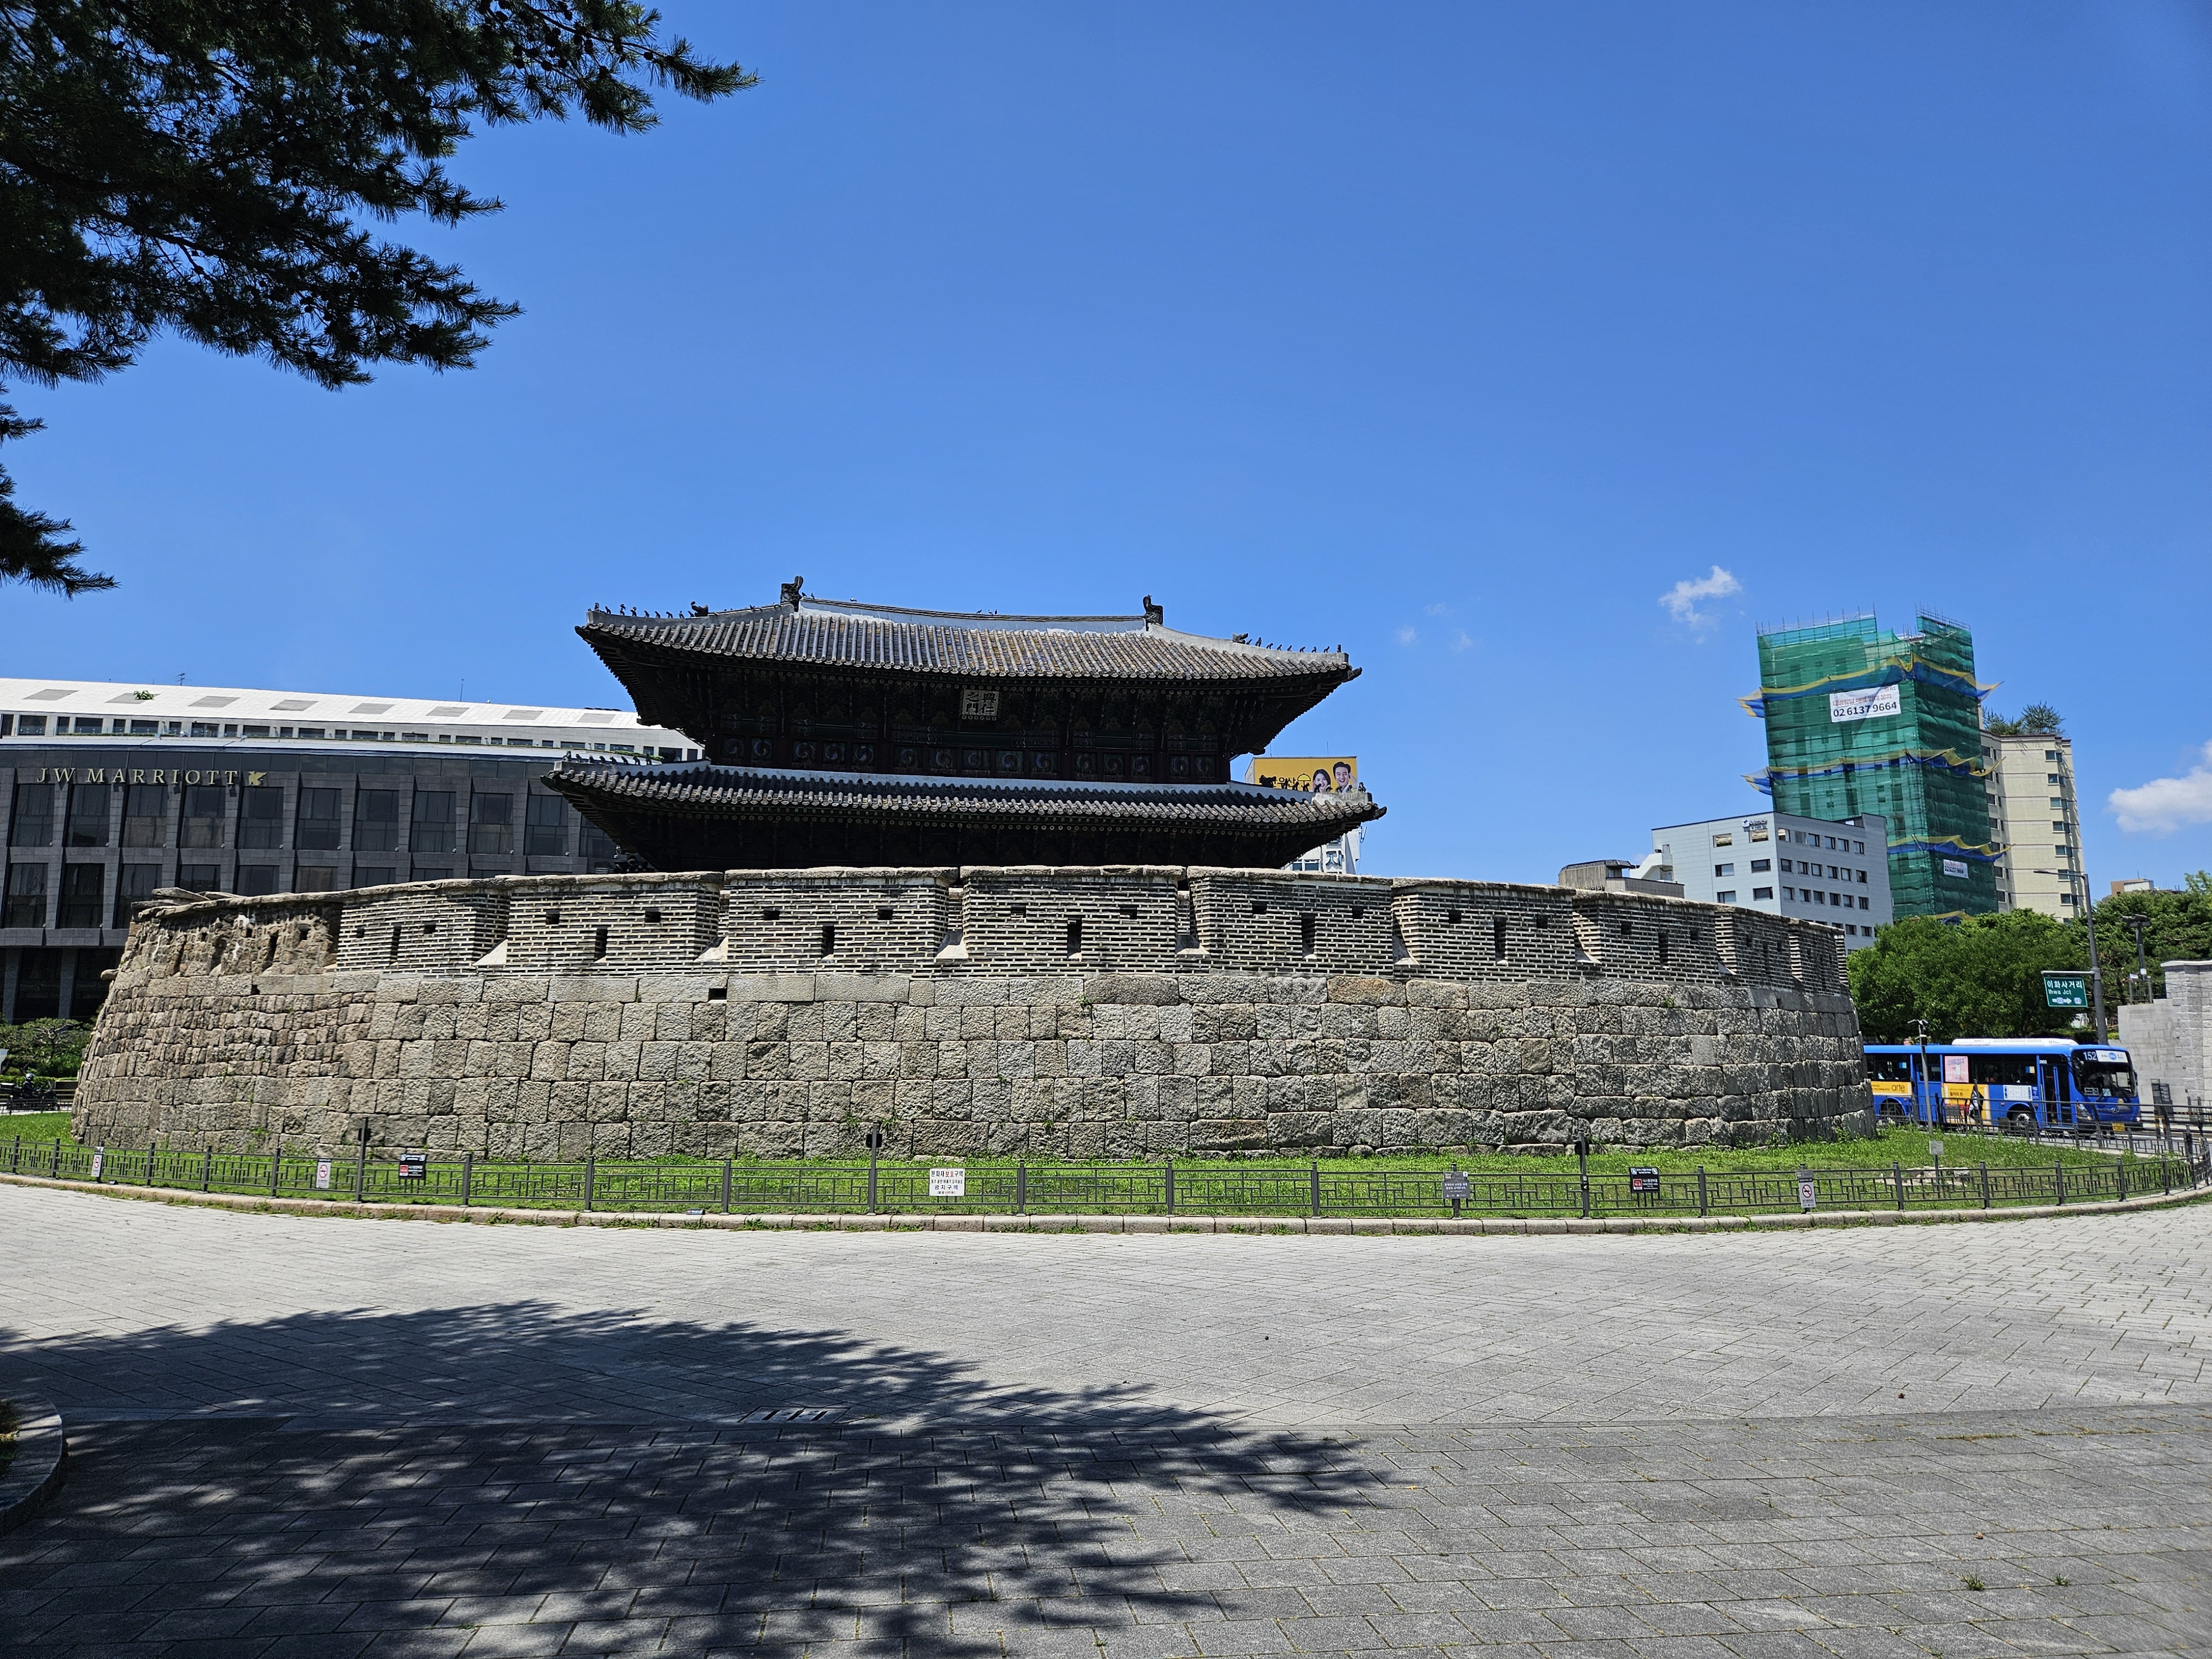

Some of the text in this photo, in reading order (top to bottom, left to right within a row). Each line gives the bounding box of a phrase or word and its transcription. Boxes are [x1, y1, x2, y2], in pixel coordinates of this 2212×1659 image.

[1833, 702, 1897, 717] 02 6137 9664
[37, 768, 238, 785] JW MARRIOTT
[2047, 980, 2083, 989] 이화사거리
[2083, 1051, 2097, 1061] 152
